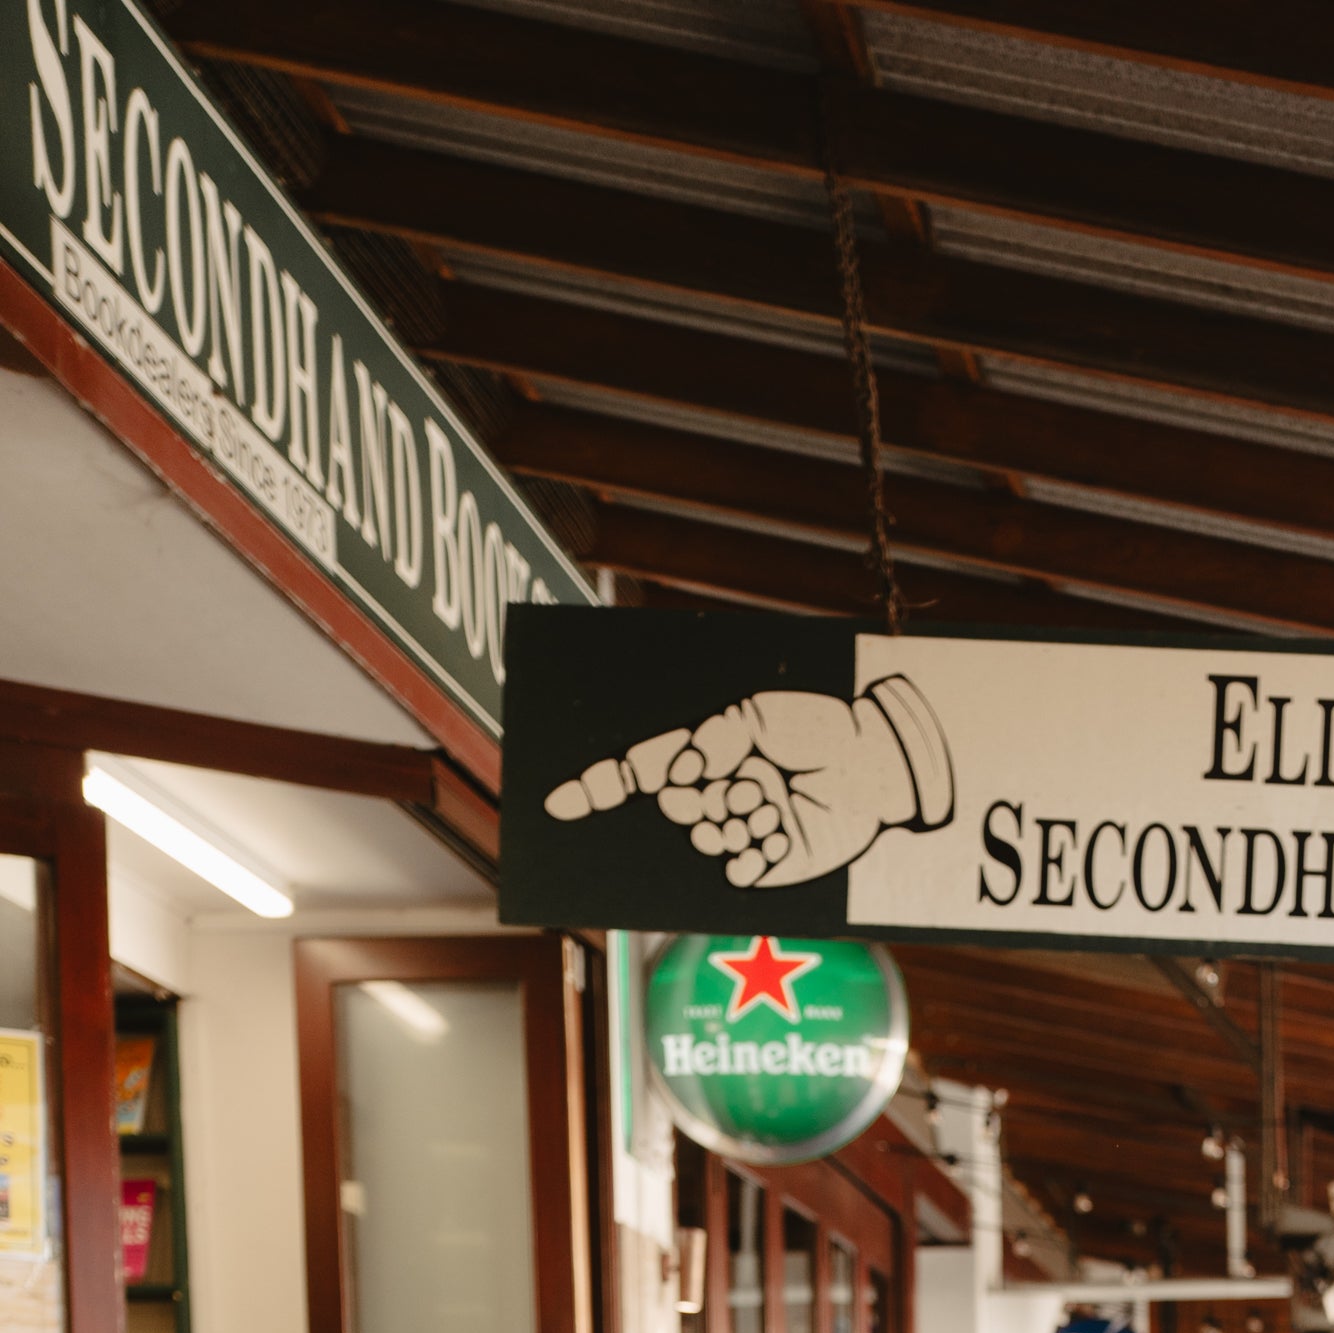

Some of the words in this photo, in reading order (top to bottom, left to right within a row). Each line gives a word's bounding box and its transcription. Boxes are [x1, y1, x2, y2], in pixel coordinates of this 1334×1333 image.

[28, 0, 422, 590] SECONDHAND
[424, 416, 558, 685] BOO
[63, 244, 213, 452] Bookdealers
[218, 406, 277, 506] Since
[662, 1032, 871, 1077] Heineken
